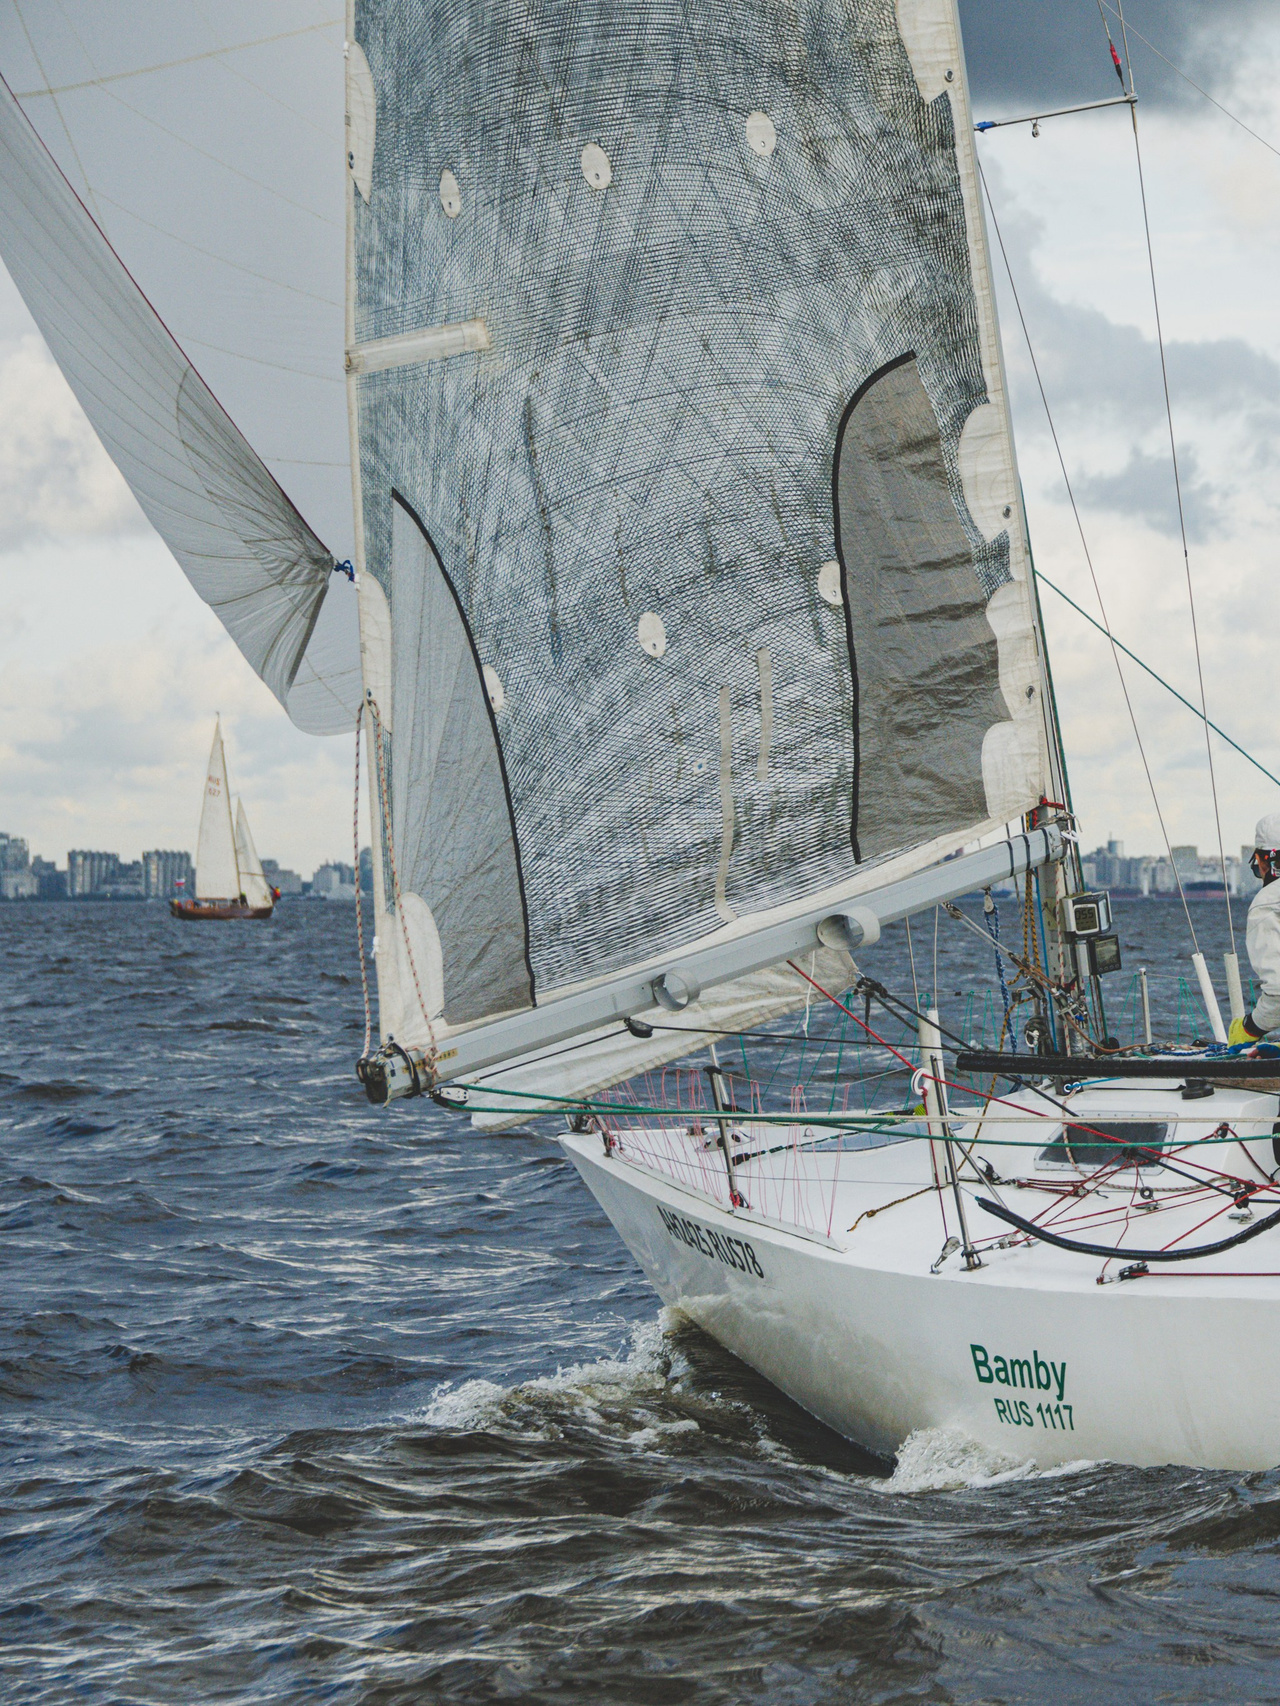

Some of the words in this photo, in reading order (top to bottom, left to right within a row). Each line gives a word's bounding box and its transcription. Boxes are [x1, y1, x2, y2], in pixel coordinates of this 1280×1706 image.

[656, 1204, 715, 1259] AH2425
[705, 1228, 765, 1279] RUS78
[970, 1343, 1067, 1402] Bamby
[993, 1398, 1035, 1428] RUS
[1036, 1402, 1075, 1431] 1117
